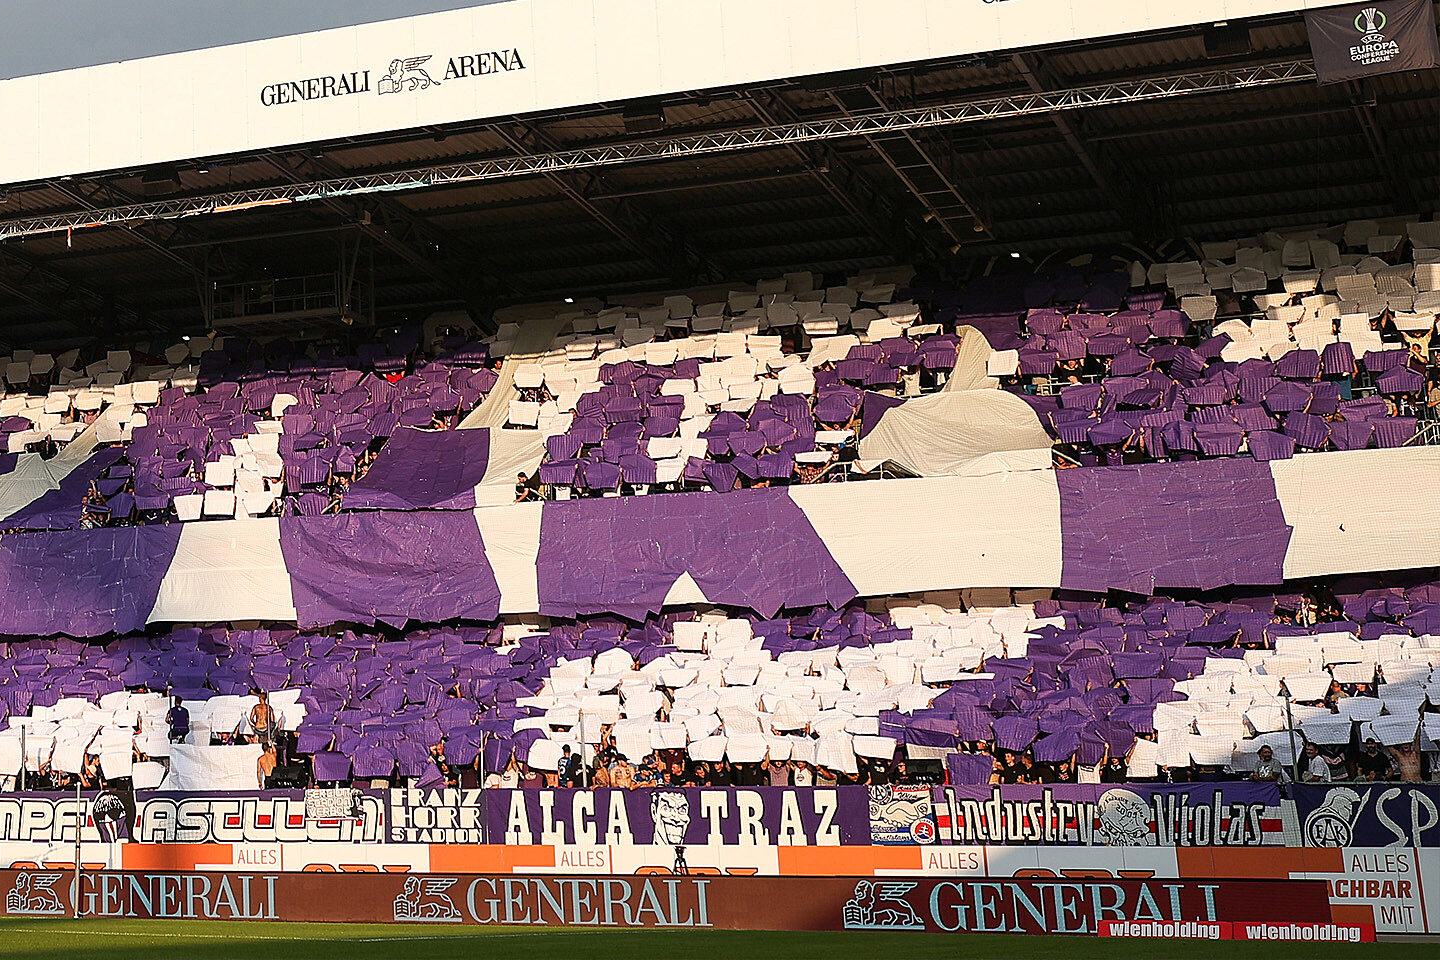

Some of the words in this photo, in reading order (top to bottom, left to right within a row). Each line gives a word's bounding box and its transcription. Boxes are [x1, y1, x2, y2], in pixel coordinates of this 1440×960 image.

[1350, 40, 1398, 56] EUROPA
[1351, 48, 1400, 62] CONFERENCE
[1361, 55, 1391, 66] LEAGUE
[260, 70, 371, 107] GENERALI
[443, 47, 526, 81] ARENA
[390, 788, 482, 807] FRANZ
[391, 806, 483, 829] HORR
[944, 786, 1095, 846] Industry
[1151, 789, 1265, 847] Violas
[391, 828, 483, 843] STADION
[238, 849, 277, 865] ALLES
[561, 851, 605, 867] ALLES
[928, 852, 979, 869] ALLES
[1351, 854, 1410, 873] ALLES
[69, 873, 280, 919] GENERALI
[467, 877, 713, 927] GENERALI
[929, 881, 1220, 934] GENERALI
[1380, 905, 1415, 925] MIT
